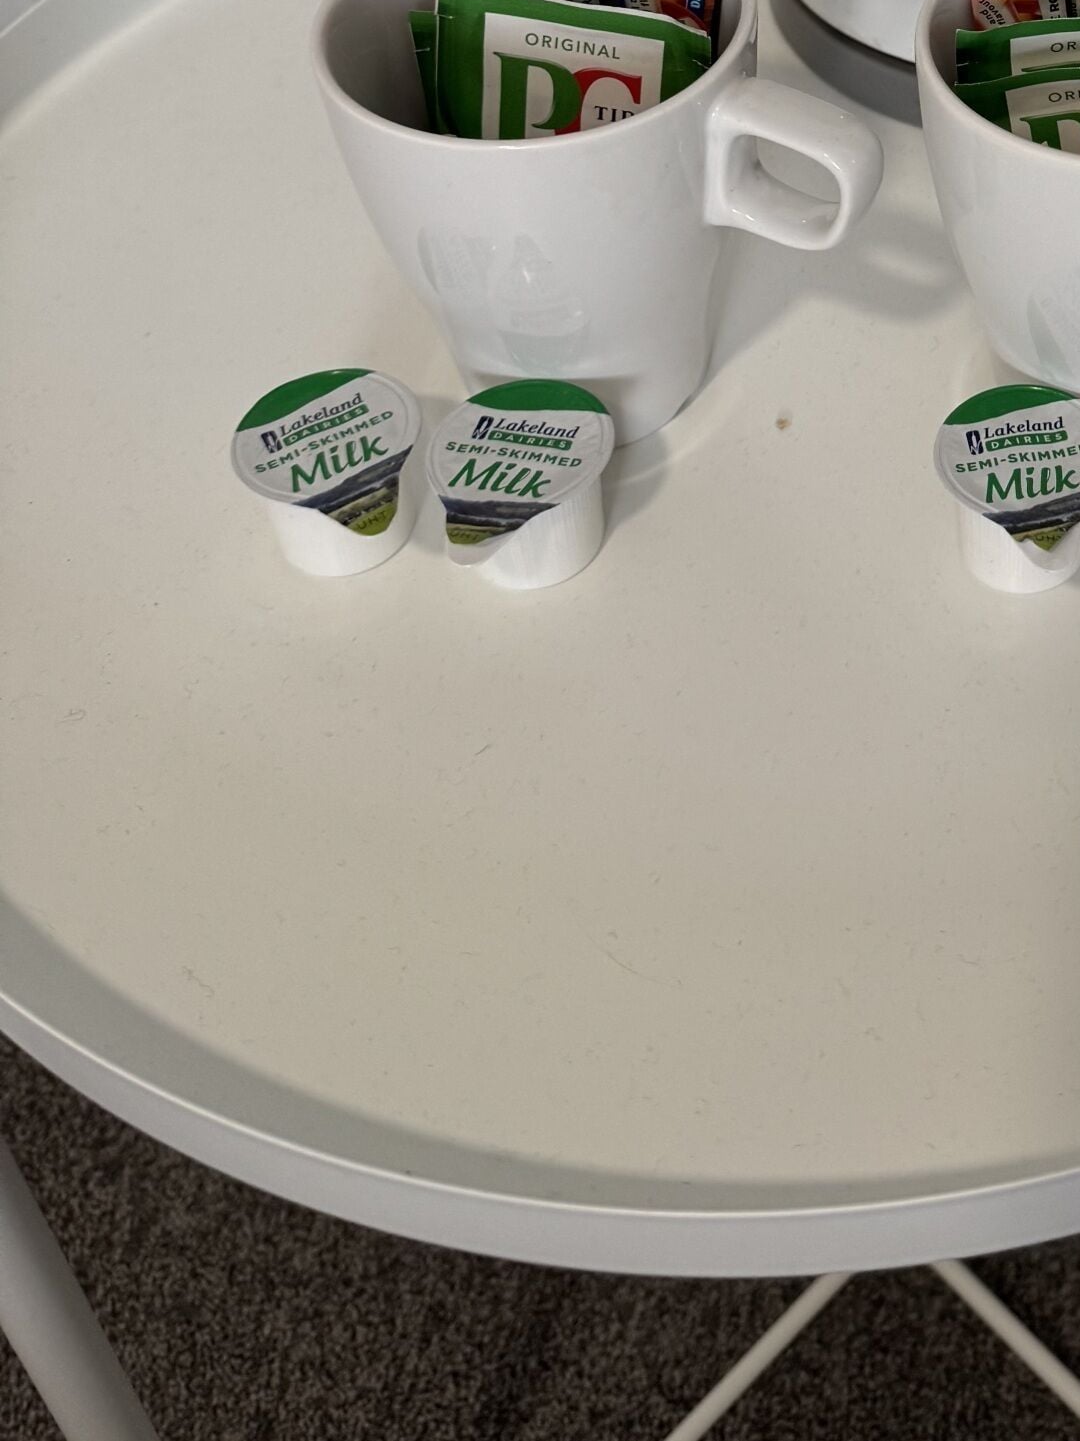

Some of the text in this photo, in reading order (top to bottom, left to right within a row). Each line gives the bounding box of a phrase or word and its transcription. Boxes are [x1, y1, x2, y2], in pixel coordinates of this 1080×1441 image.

[525, 33, 620, 60] ORIGINAL
[279, 392, 364, 438] Lakeland
[288, 408, 364, 443] DAIRIES
[494, 418, 580, 439] Lakeland
[984, 416, 1065, 439] Lakeland
[254, 410, 394, 474] SEMI-SKIMMED
[445, 441, 583, 468] SEMI-SKIMMED
[493, 432, 567, 449] DAIRIES
[991, 433, 1063, 449] DAIRIES
[290, 435, 389, 493] Milk
[448, 458, 552, 499] Milk
[985, 465, 1080, 504] Milk
